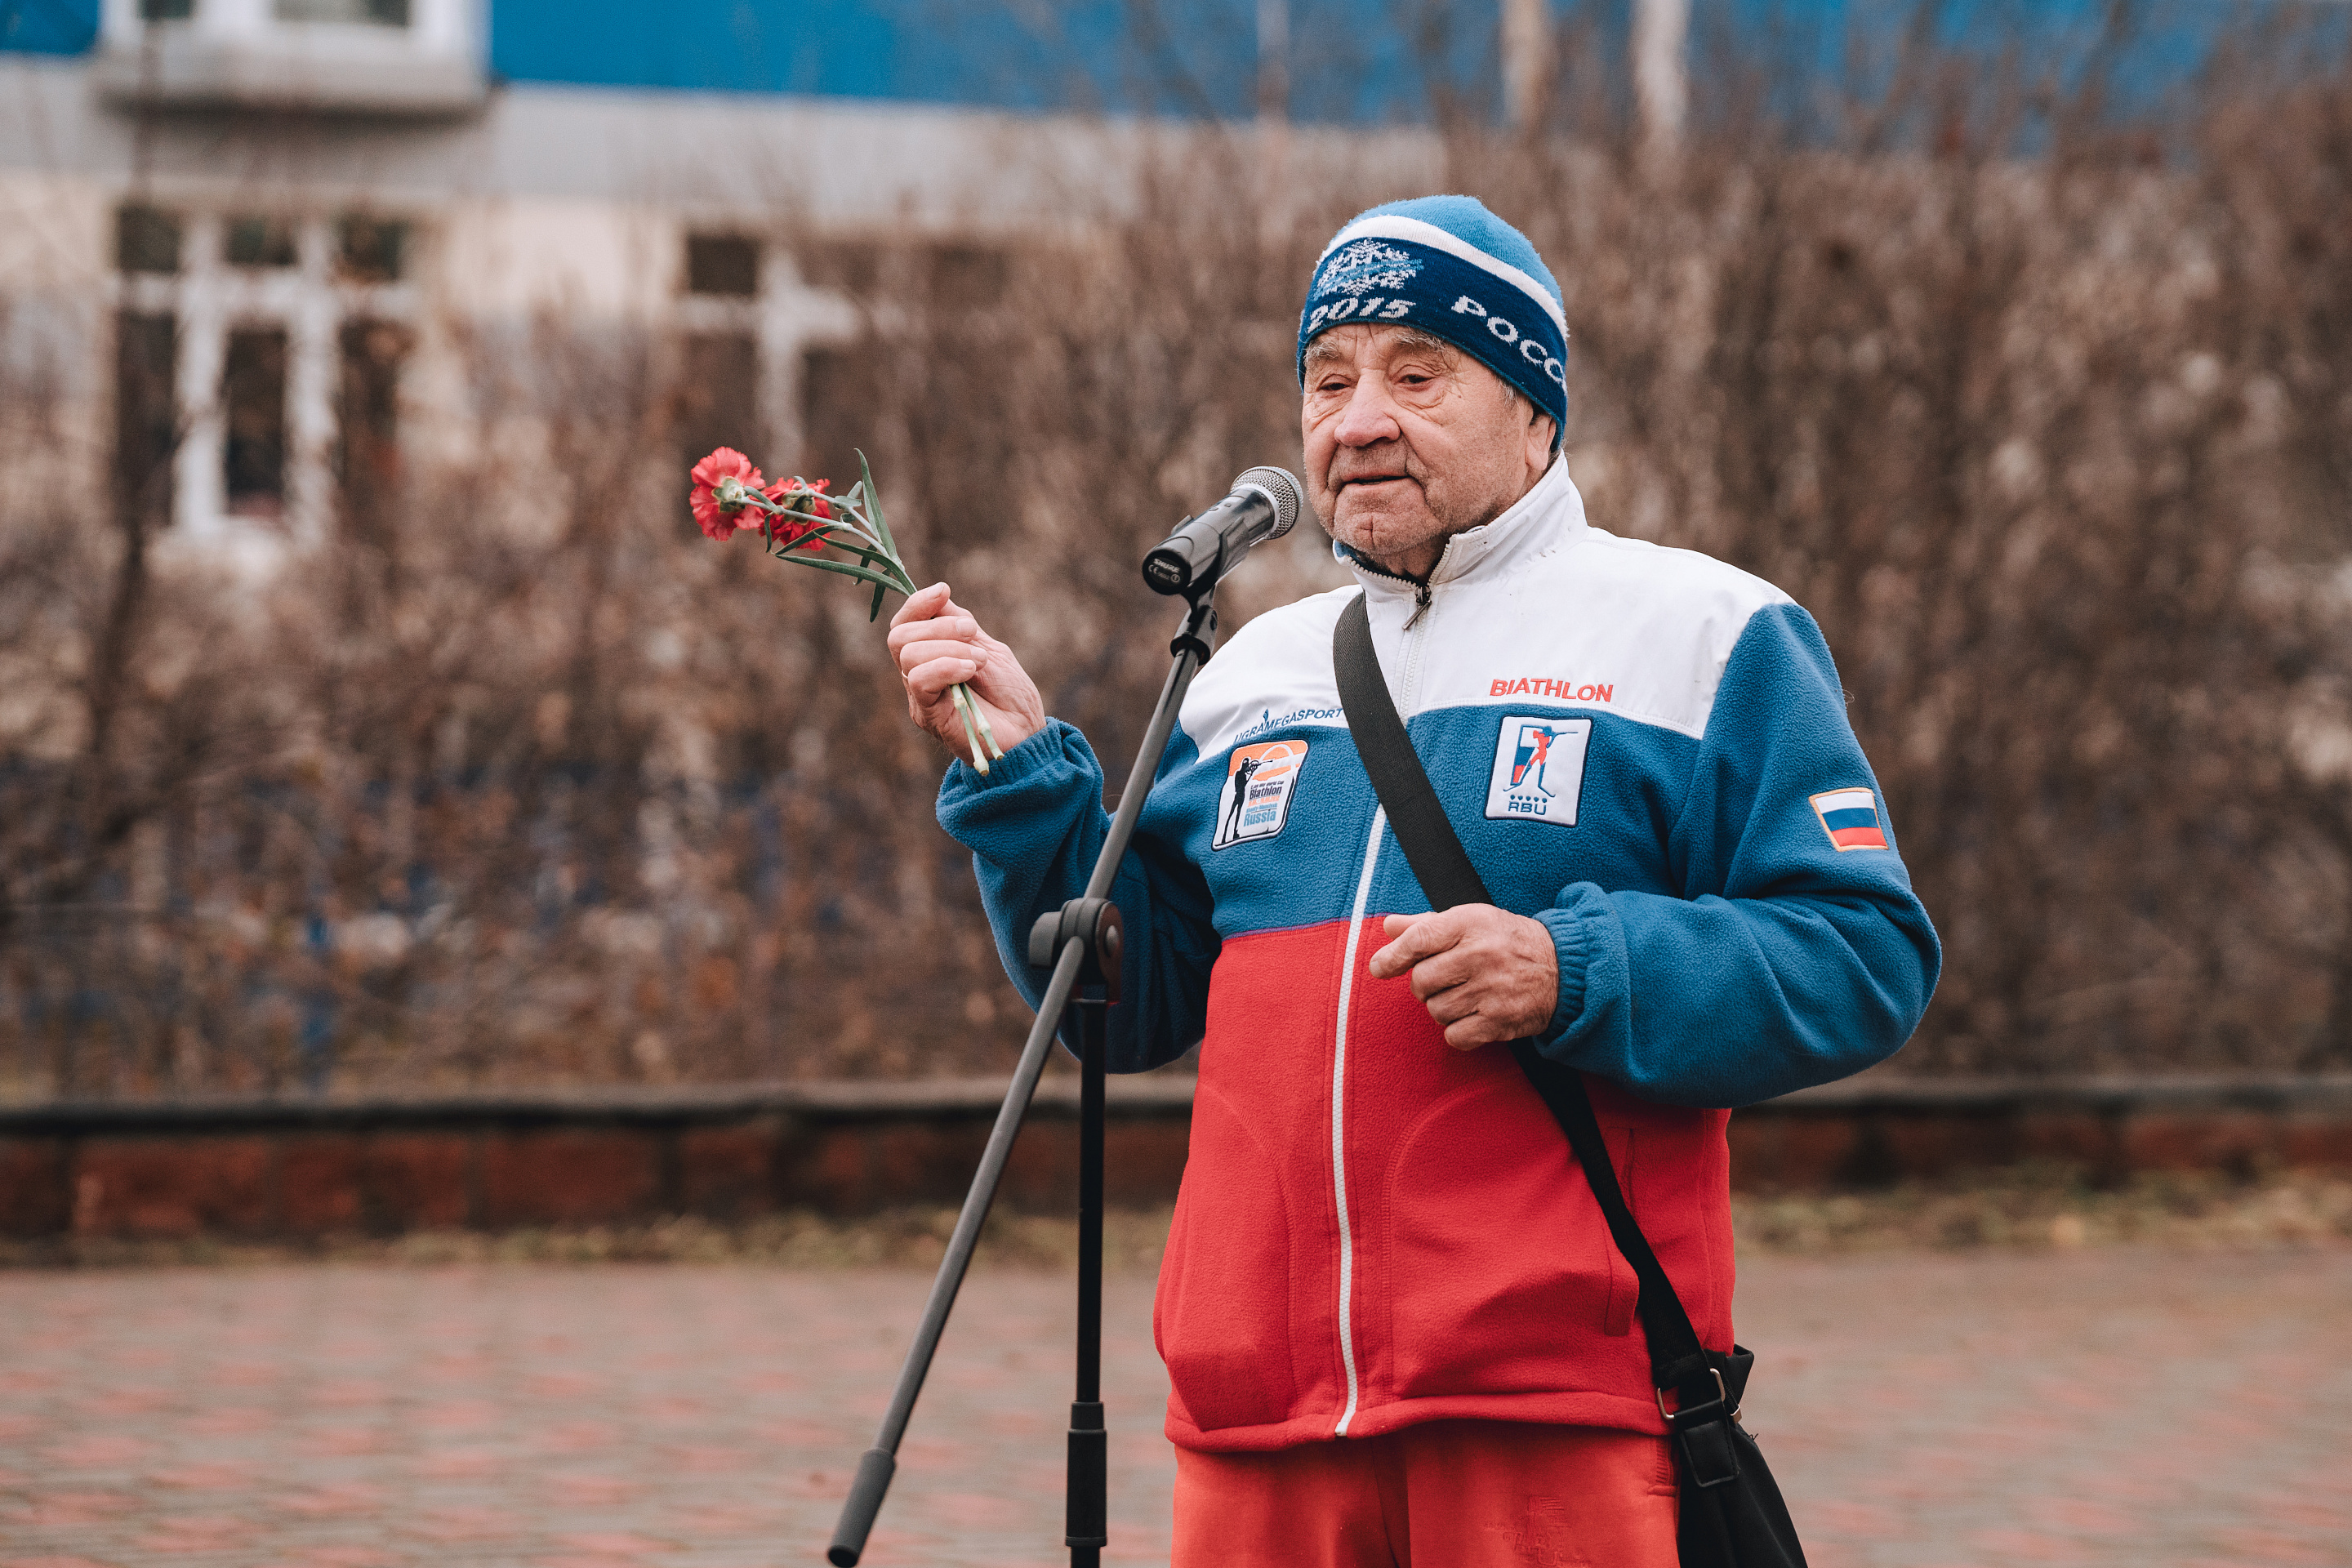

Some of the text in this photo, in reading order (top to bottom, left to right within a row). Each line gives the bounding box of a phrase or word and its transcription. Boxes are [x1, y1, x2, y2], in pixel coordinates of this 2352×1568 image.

[1307, 297, 1416, 333] 2015
[1451, 295, 1567, 396] РОСС
[1153, 559, 1180, 572] SHURE
[1490, 677, 1614, 702] BIATHLON
[1249, 786, 1282, 800] Biathlon
[1508, 801, 1547, 815] RBU
[1244, 810, 1276, 826] Russia
